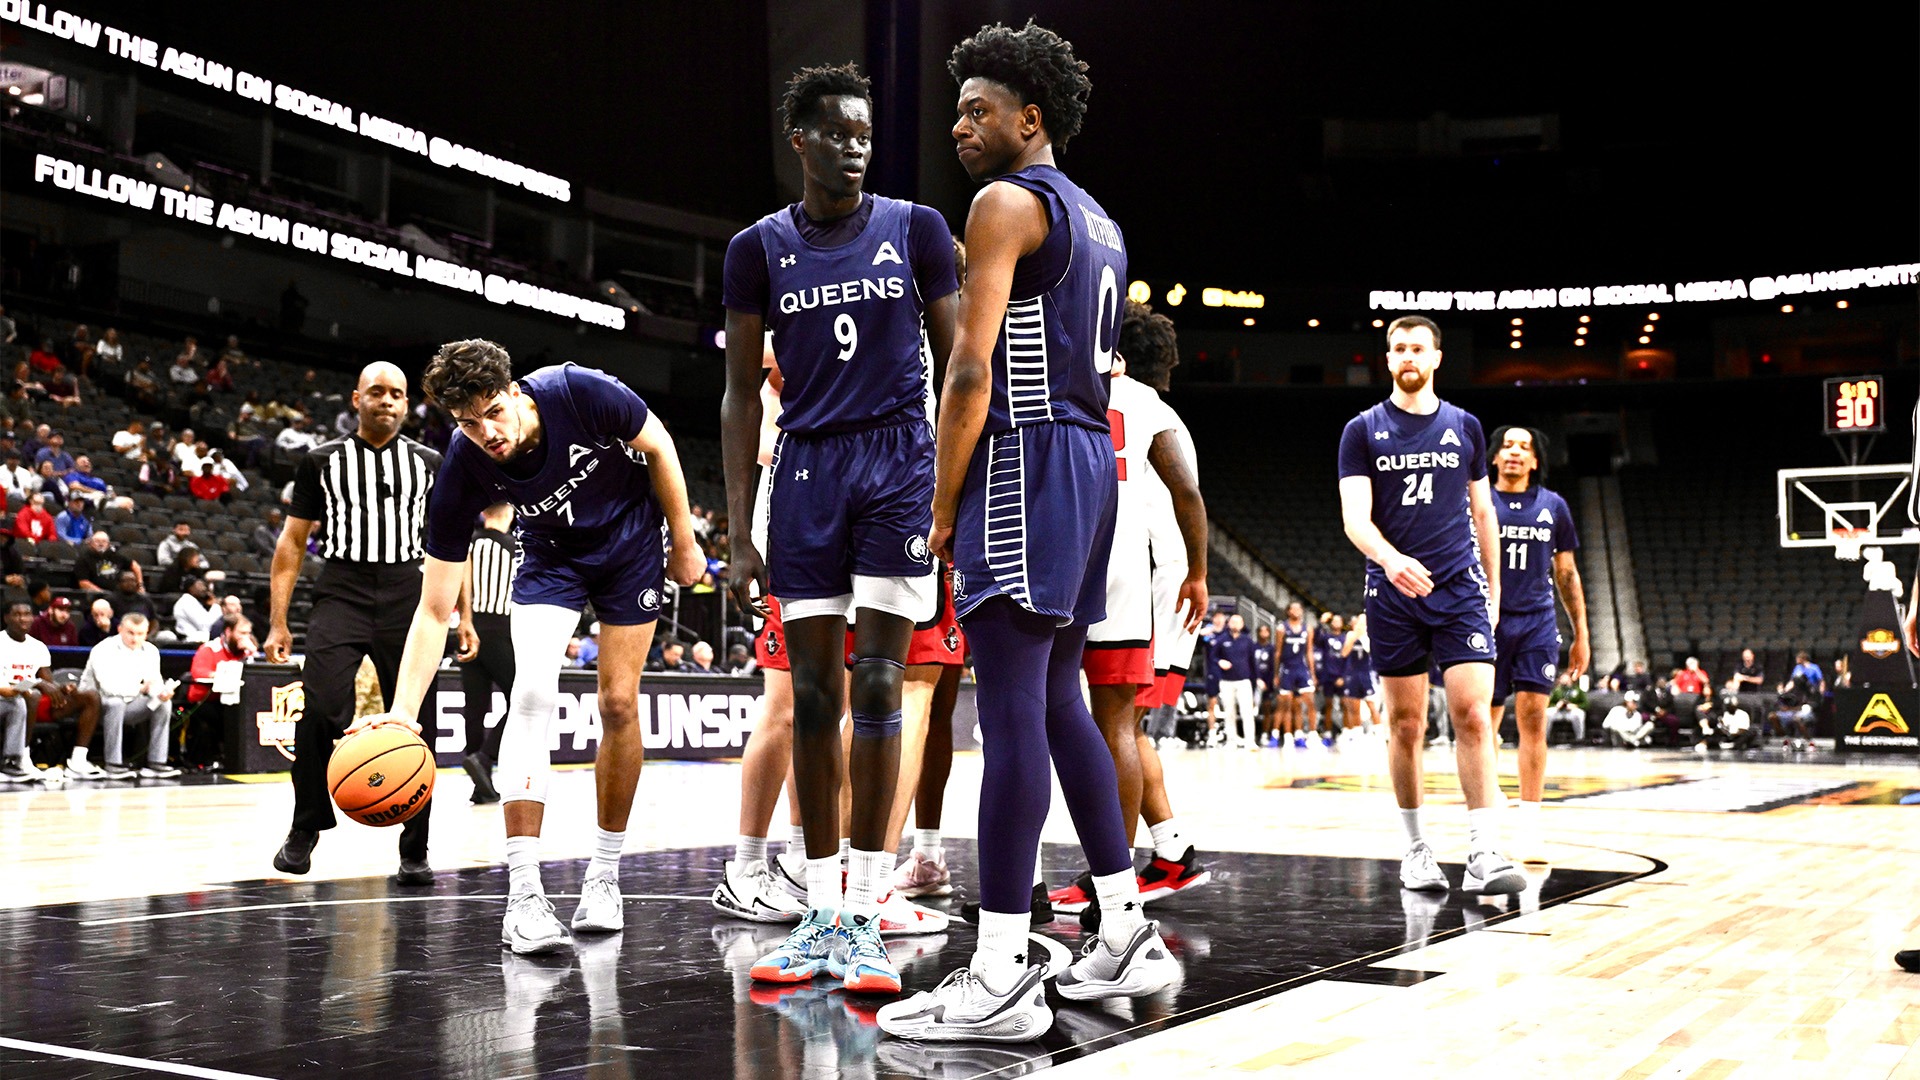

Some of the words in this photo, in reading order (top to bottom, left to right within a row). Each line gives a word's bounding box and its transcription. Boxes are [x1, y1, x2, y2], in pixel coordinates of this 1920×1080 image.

[104, 26, 158, 67] THE
[160, 47, 233, 92] ASUN
[235, 71, 273, 104] ON
[274, 84, 358, 133] SOCIAL
[359, 112, 428, 156] MEDIA
[34, 153, 158, 210] FOLLOW
[159, 186, 215, 225] THE
[216, 203, 290, 245] ASUN
[291, 222, 328, 254] ON
[330, 232, 414, 277] SOCIAL
[415, 254, 484, 295] MEDIA
[779, 276, 905, 315] QUEENS
[1369, 291, 1453, 311] FOLLOW
[1453, 291, 1497, 311] THE
[1496, 288, 1557, 309] ASUN
[1558, 286, 1592, 308] ON
[1592, 284, 1674, 306] SOCIAL
[1674, 278, 1748, 303] MEDIA
[833, 313, 858, 362] 9
[1836, 397, 1874, 428] 30
[1375, 451, 1460, 472] QUEENS
[520, 457, 600, 518] UEENS
[1401, 473, 1434, 506] 24
[556, 500, 576, 527] 7
[1498, 526, 1552, 543] UEENS
[1506, 542, 1528, 570] 11
[1844, 735, 1861, 746] THE
[361, 783, 429, 824] Wilson
